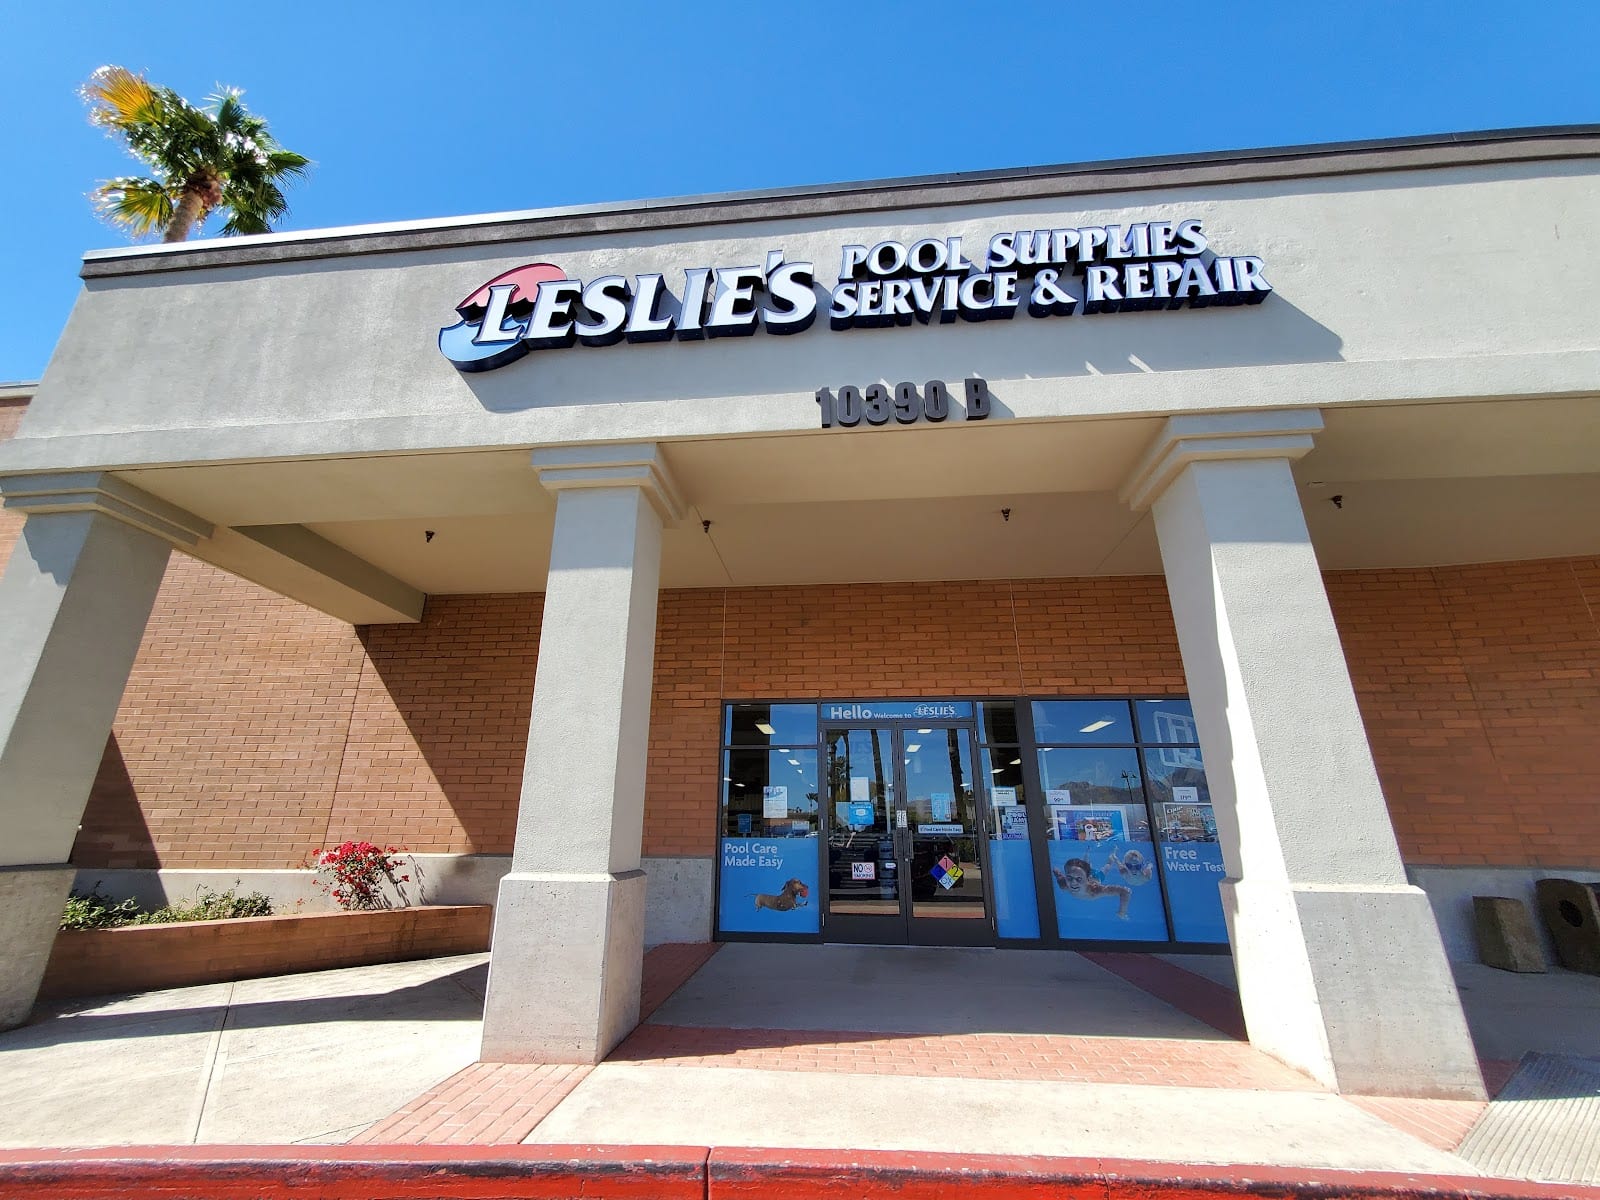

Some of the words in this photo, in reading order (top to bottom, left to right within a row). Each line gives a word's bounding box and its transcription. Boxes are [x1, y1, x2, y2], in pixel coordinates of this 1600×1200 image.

[840, 236, 972, 280] POOL
[986, 218, 1208, 269] SUPPLIES
[830, 270, 1021, 322] SERVICE
[1030, 268, 1078, 308] &
[1086, 255, 1273, 306] REPAIR
[471, 250, 817, 346] LESLIE'S
[815, 378, 948, 429] 10390
[964, 377, 991, 421] B
[830, 704, 873, 720] Hello
[873, 711, 903, 719] Welcome
[724, 842, 749, 854] Pool
[751, 843, 778, 854] Care
[1164, 846, 1198, 860] Free
[724, 855, 756, 867] Made
[758, 856, 784, 870] Easy
[853, 863, 864, 873] NO
[1166, 861, 1201, 872] Water
[951, 865, 959, 878] 2
